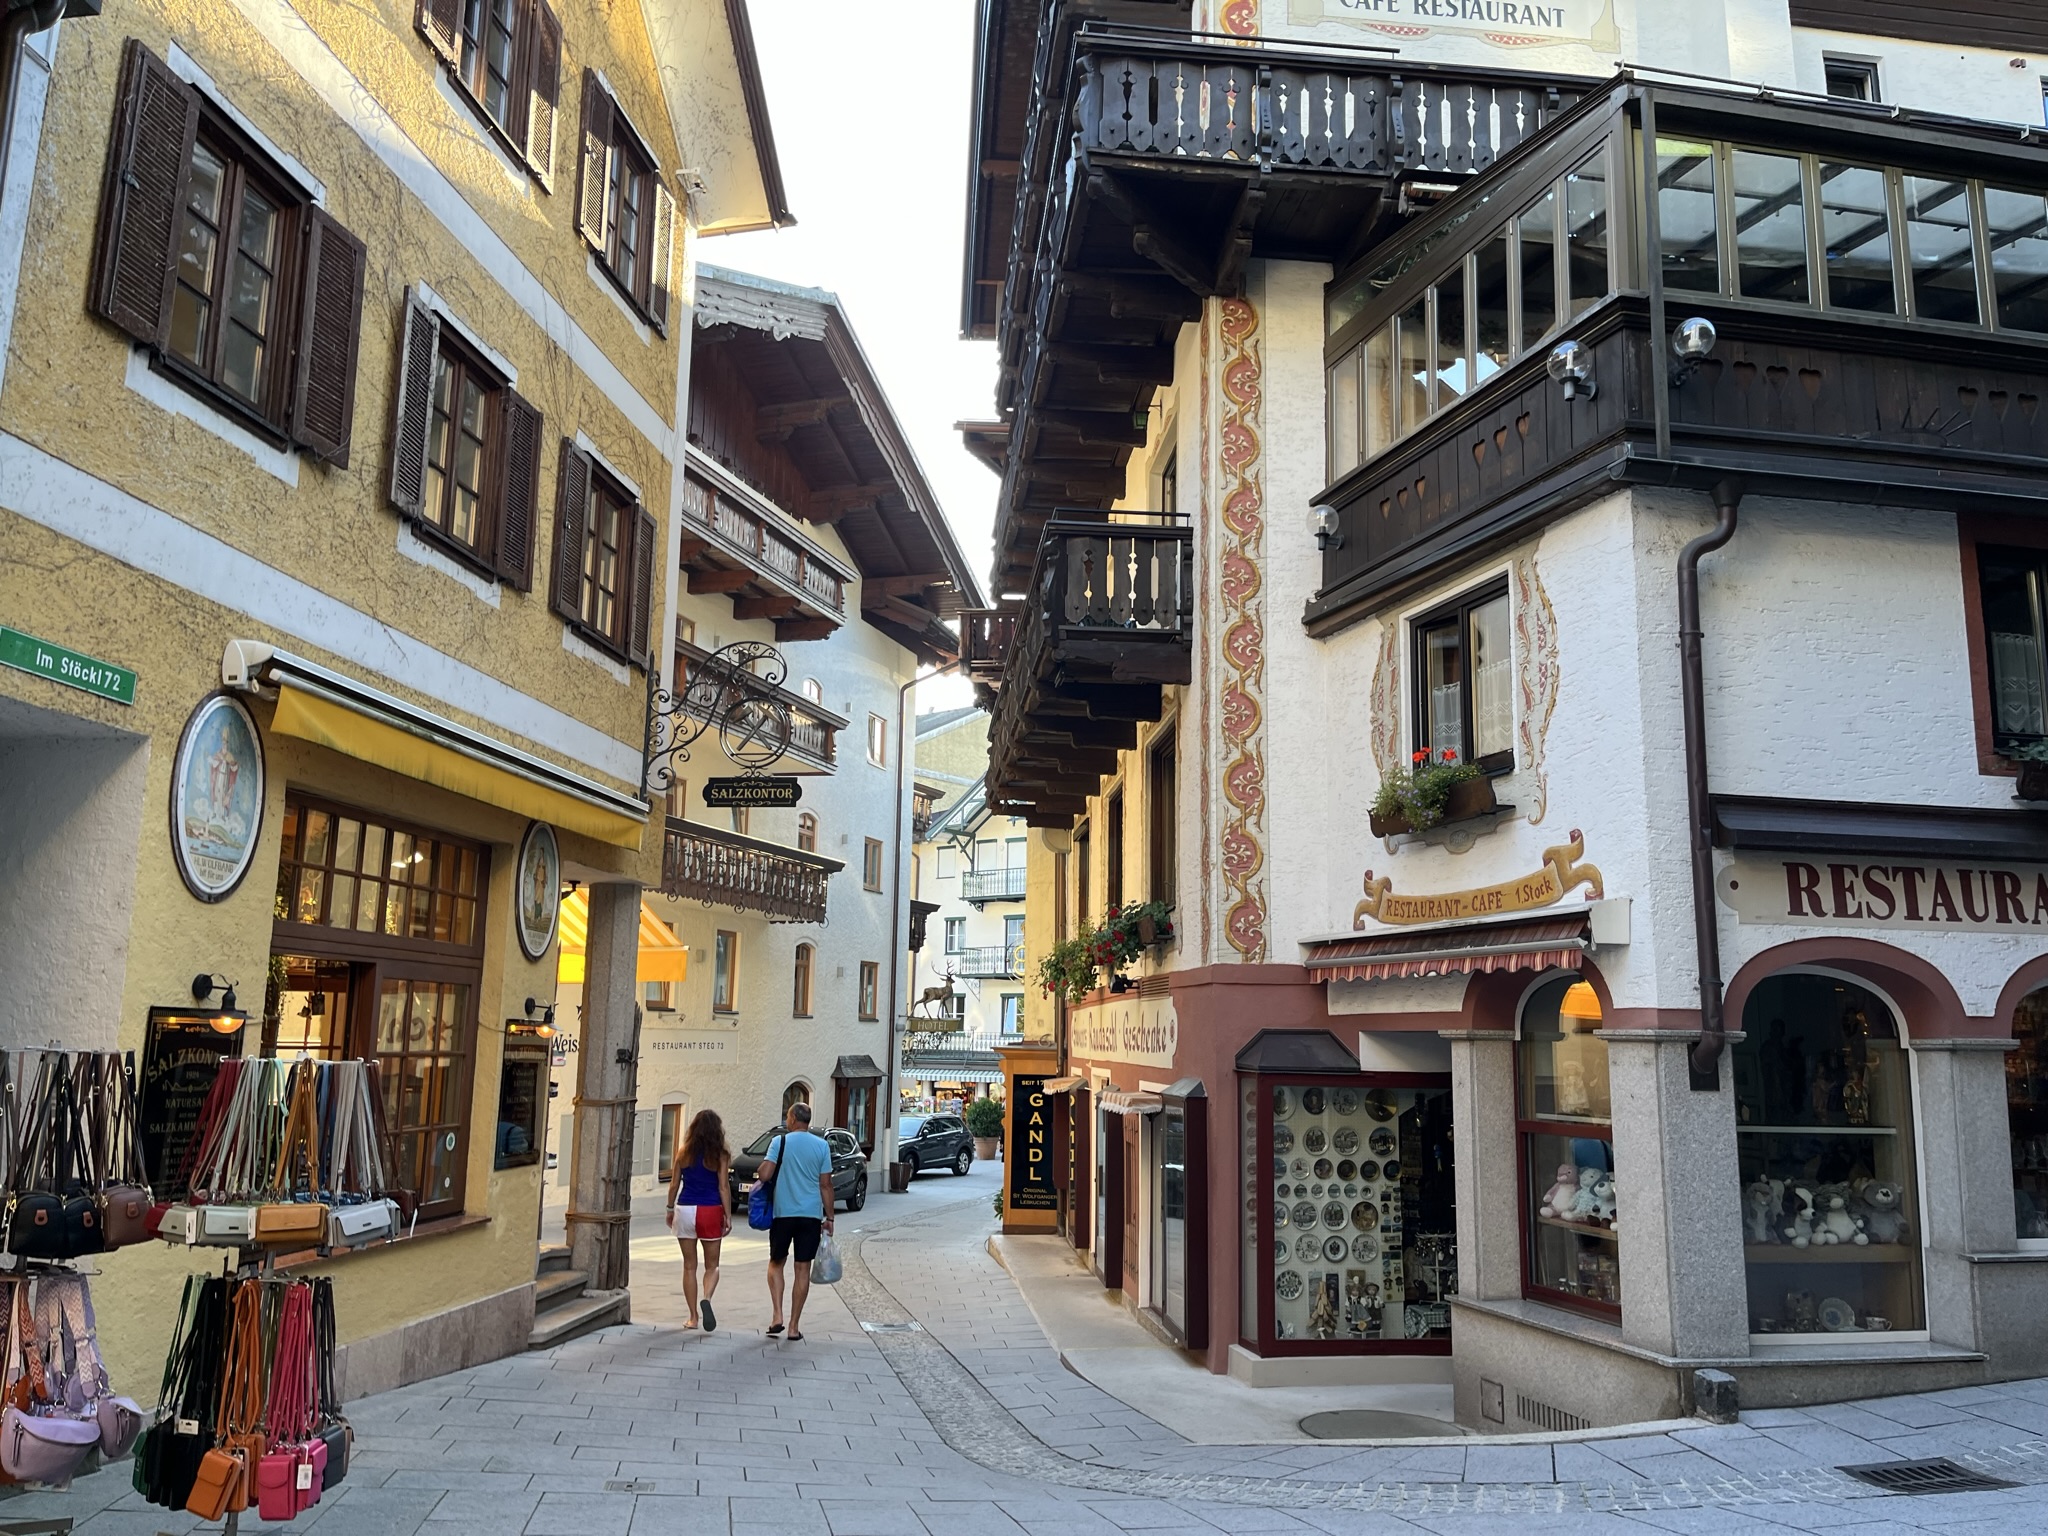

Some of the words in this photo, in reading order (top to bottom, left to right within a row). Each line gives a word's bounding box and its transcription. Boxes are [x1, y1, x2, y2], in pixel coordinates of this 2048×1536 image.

[1413, 0, 1565, 28] RESTAURANT
[36, 647, 54, 669] Im
[60, 656, 102, 686] Stöckl
[104, 671, 121, 692] 72
[710, 788, 793, 799] SALZKONTOR
[1386, 897, 1461, 918] RESTAURANT
[1471, 890, 1503, 912] CAFE
[917, 1021, 949, 1031] HOTEL
[652, 1041, 696, 1050] RESTAURANT
[698, 1041, 715, 1050] STEG
[717, 1042, 724, 1050] 73
[1028, 1092, 1044, 1182] GANDL
